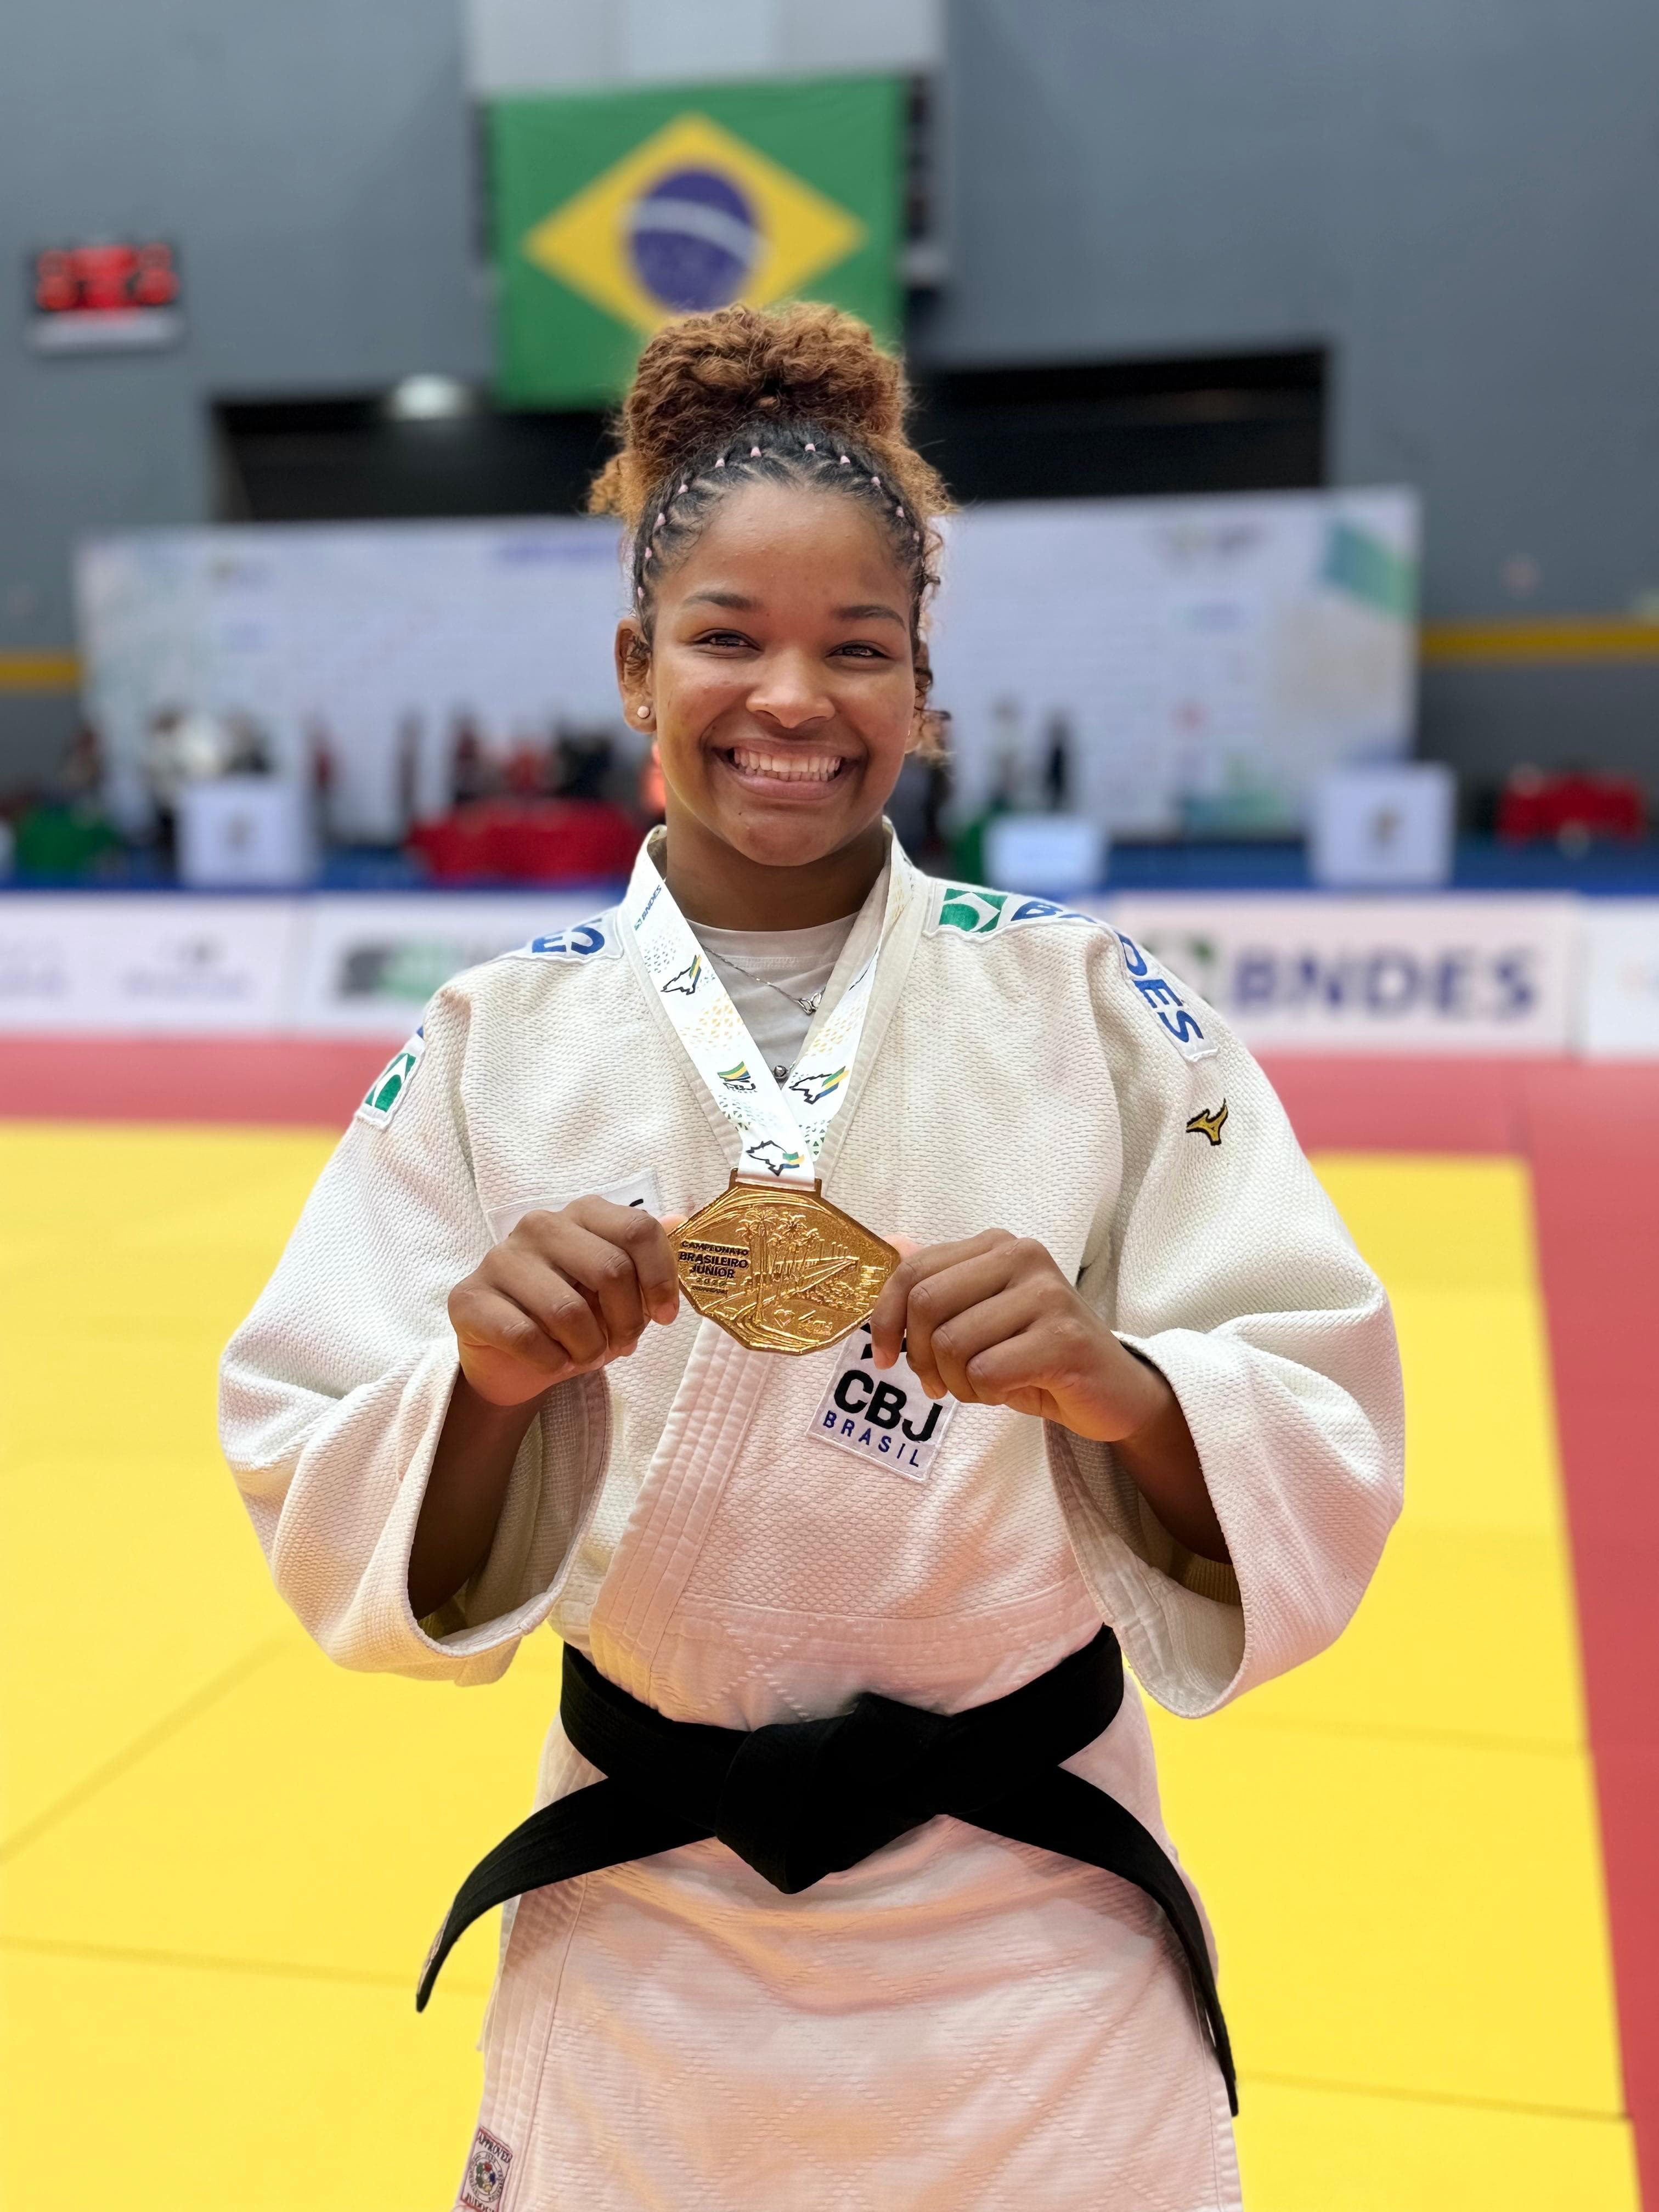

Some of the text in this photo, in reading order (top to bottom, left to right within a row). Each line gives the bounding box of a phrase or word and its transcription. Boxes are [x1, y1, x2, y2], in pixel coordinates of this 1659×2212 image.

[679, 1251, 748, 1268] BRASILEIRO
[834, 1369, 943, 1442] CBJ
[823, 1410, 919, 1467] BRASIL
